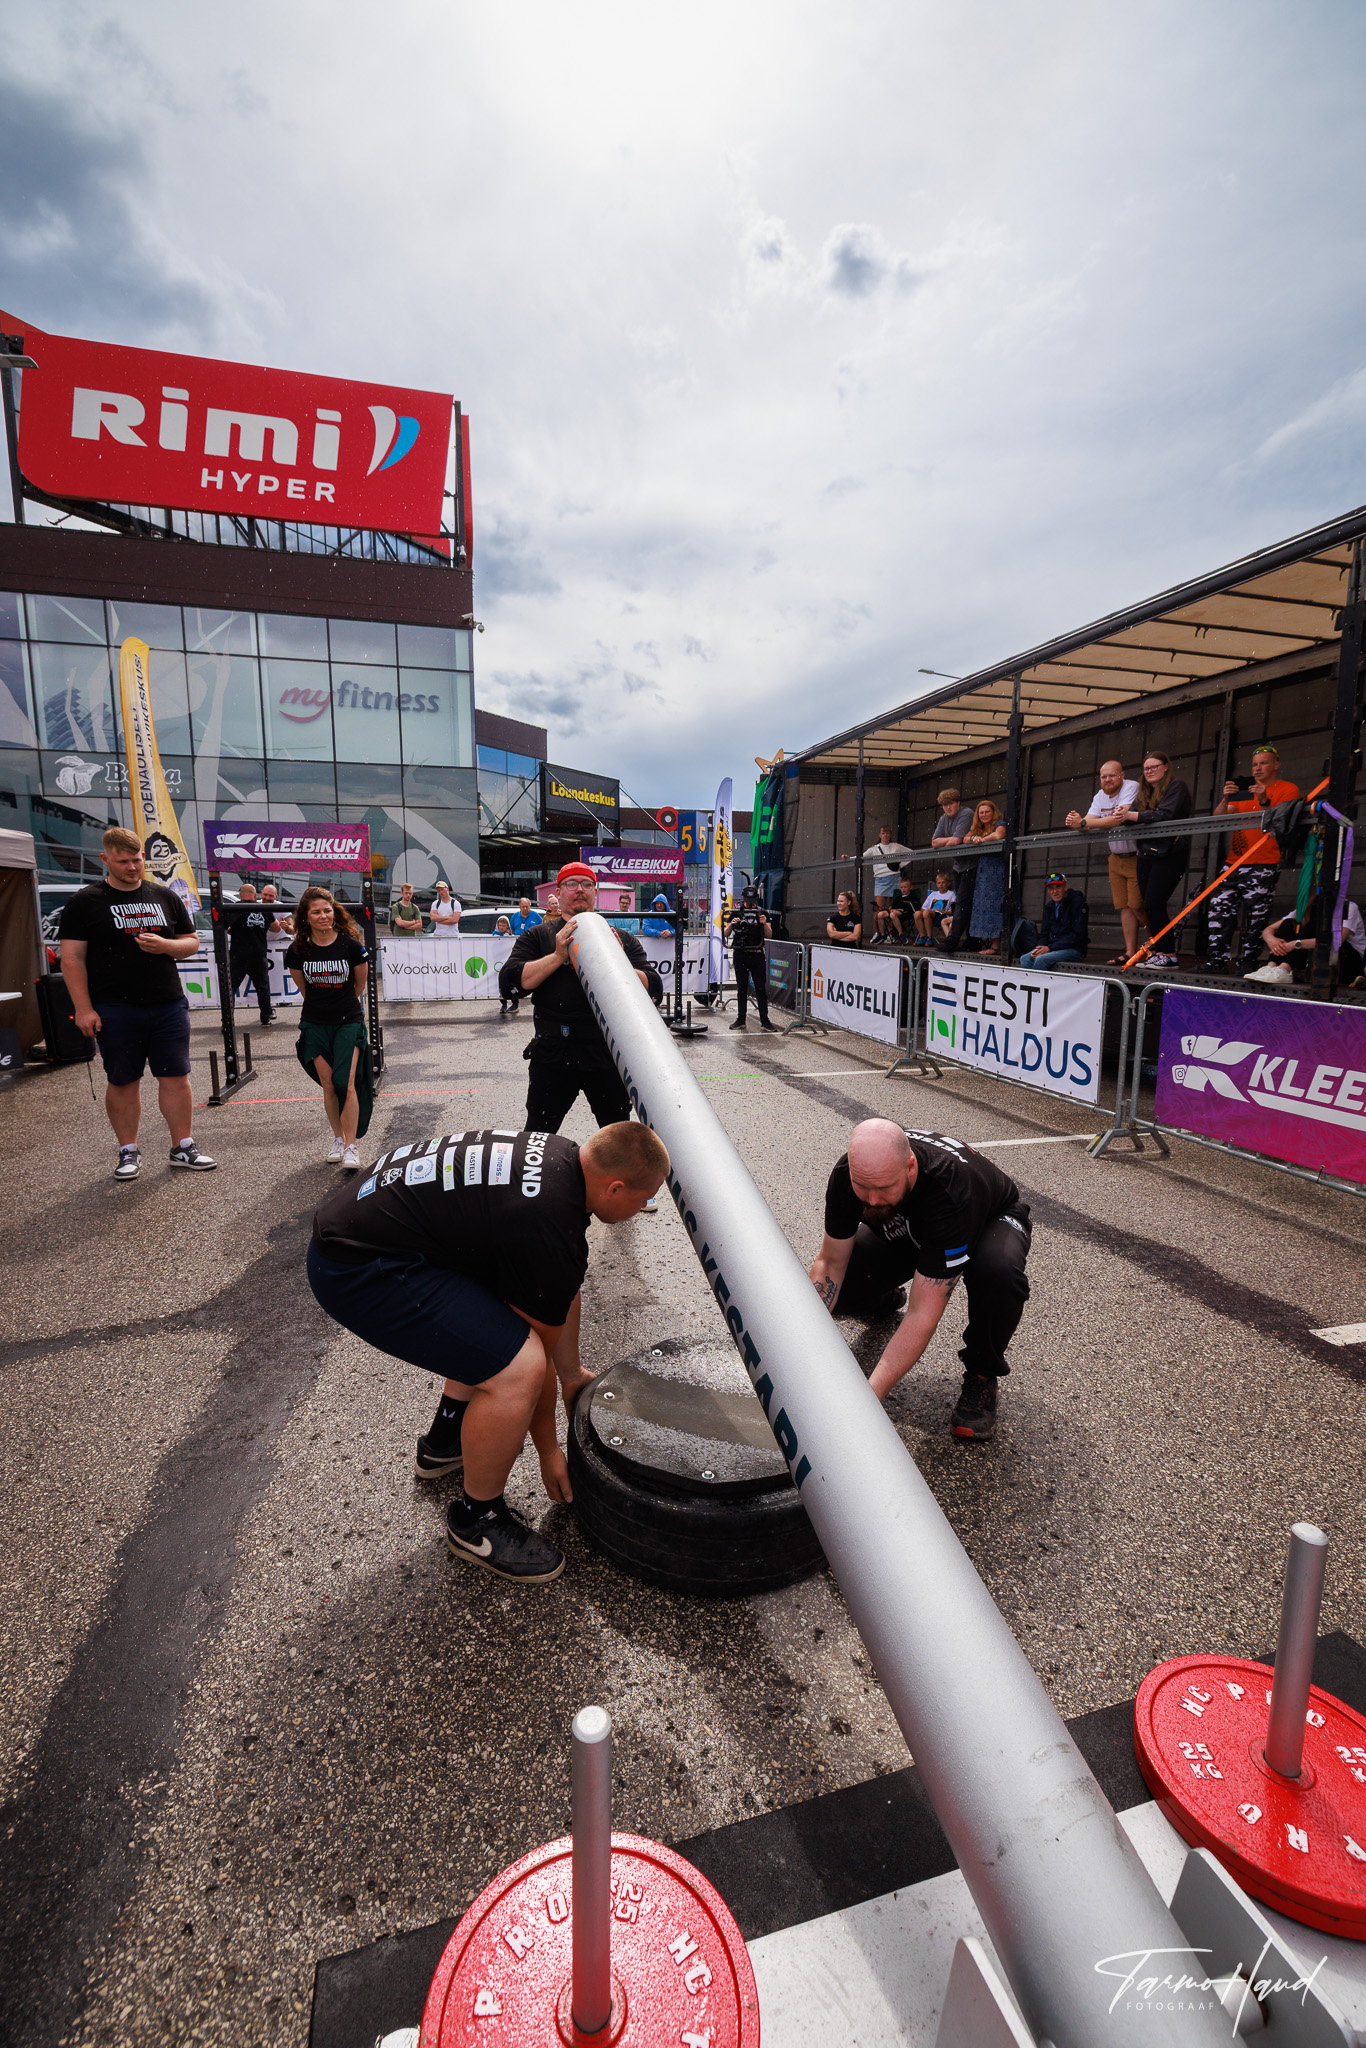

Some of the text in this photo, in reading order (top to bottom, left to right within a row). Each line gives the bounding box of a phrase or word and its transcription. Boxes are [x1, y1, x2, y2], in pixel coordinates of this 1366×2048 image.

[71, 386, 342, 472] Rimi
[201, 468, 336, 503] HYPER
[279, 680, 440, 723] myfitness
[550, 781, 616, 807] Lõunakeskus
[152, 844, 170, 858] 23
[254, 837, 362, 853] KLEEBIKUM
[681, 825, 693, 852] 5
[698, 825, 707, 852] 5
[611, 858, 680, 870] KLEEBIKUM
[386, 962, 458, 975] Woodwell
[827, 979, 896, 1018] KASTELLI
[963, 976, 1049, 1028] EESTI
[961, 1017, 1093, 1087] HALDUS
[1249, 1054, 1366, 1112] KLEE
[1178, 1741, 1215, 1761] 25
[1189, 1763, 1224, 1780] KG
